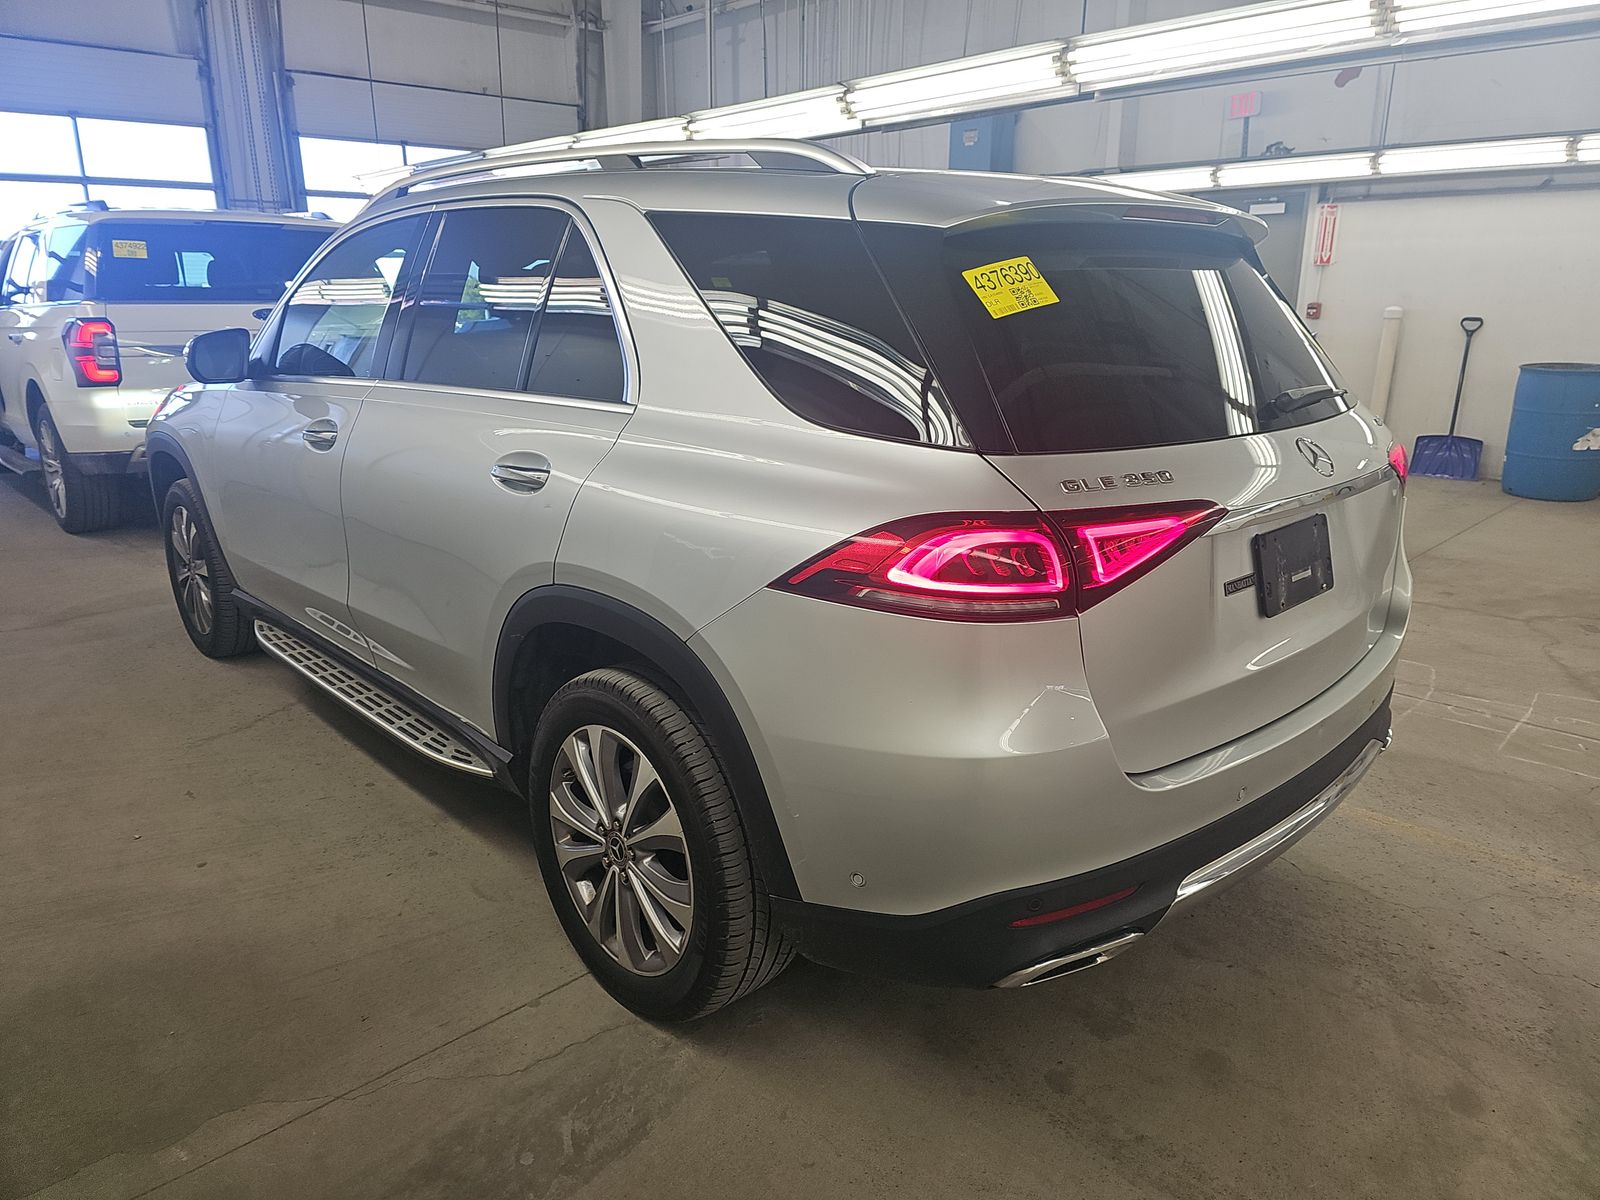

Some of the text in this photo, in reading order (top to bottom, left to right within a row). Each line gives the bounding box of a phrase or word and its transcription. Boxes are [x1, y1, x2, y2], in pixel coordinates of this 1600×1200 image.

[1231, 91, 1257, 116] EXIT
[973, 261, 1041, 292] 4376390
[985, 298, 1001, 308] DLR
[1060, 469, 1175, 494] GLE 350
